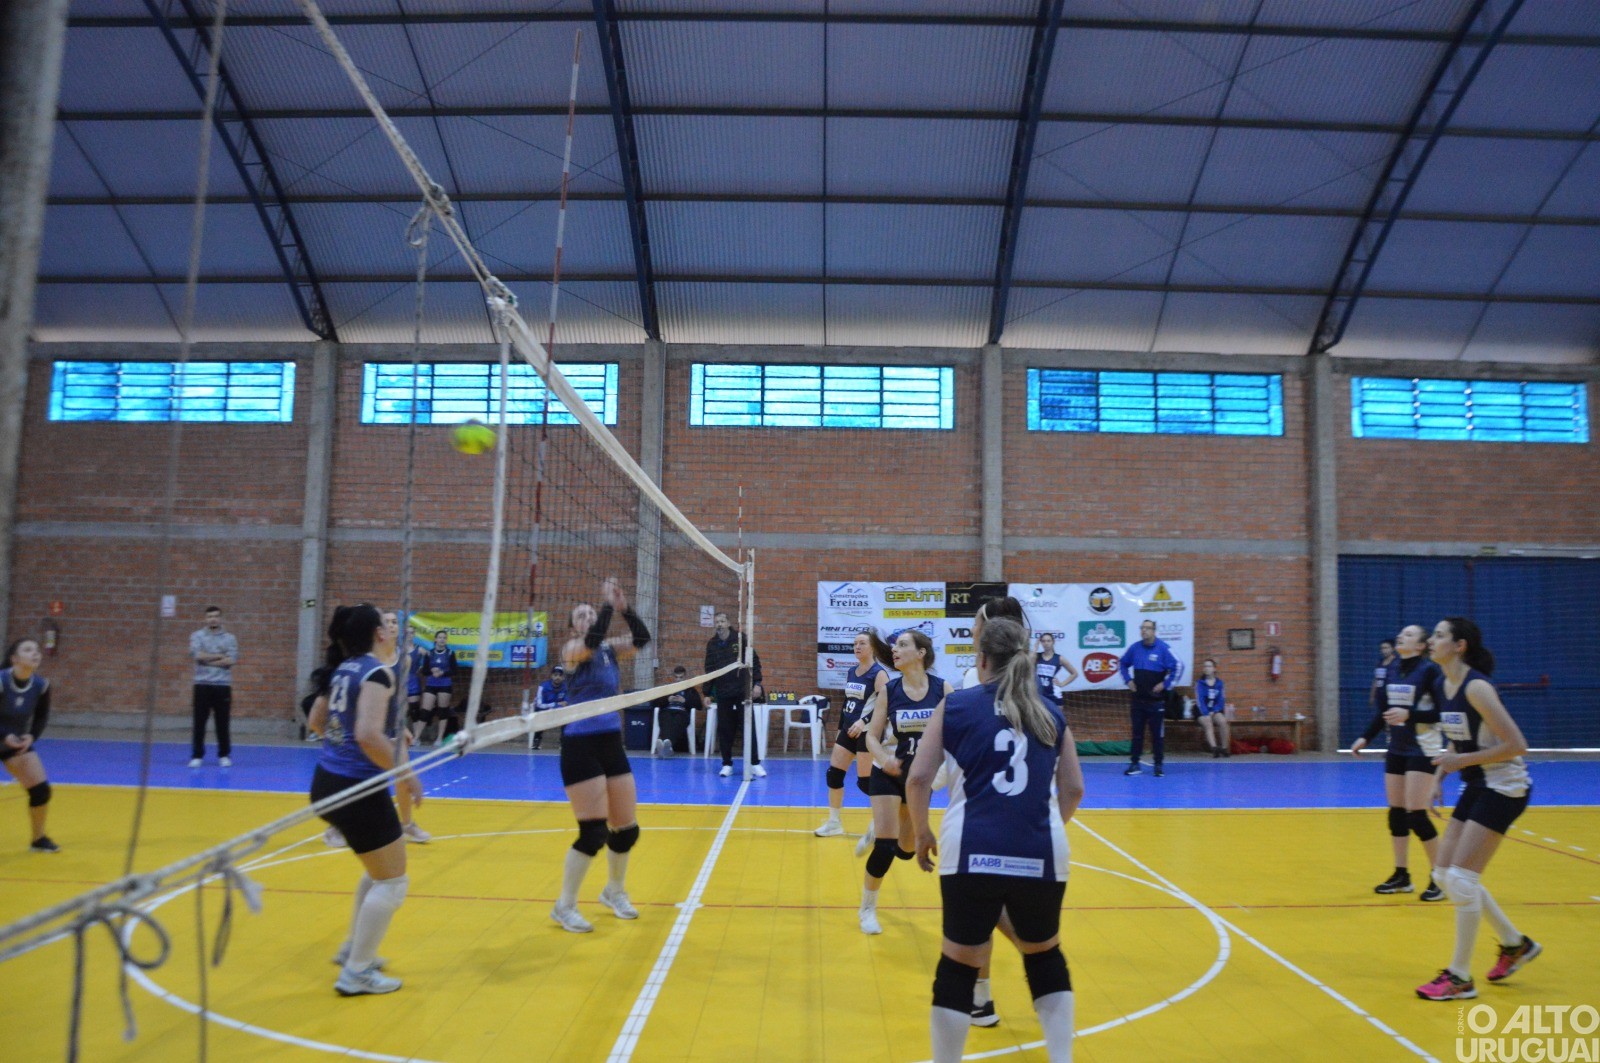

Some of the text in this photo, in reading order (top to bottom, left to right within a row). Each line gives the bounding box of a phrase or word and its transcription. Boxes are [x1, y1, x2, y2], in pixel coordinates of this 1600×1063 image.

[830, 599, 869, 607] Freitas
[950, 593, 971, 604] RT
[949, 628, 974, 638] VID
[1084, 658, 1118, 672] AB&S
[991, 727, 1029, 797] 3
[971, 856, 1002, 868] AABB
